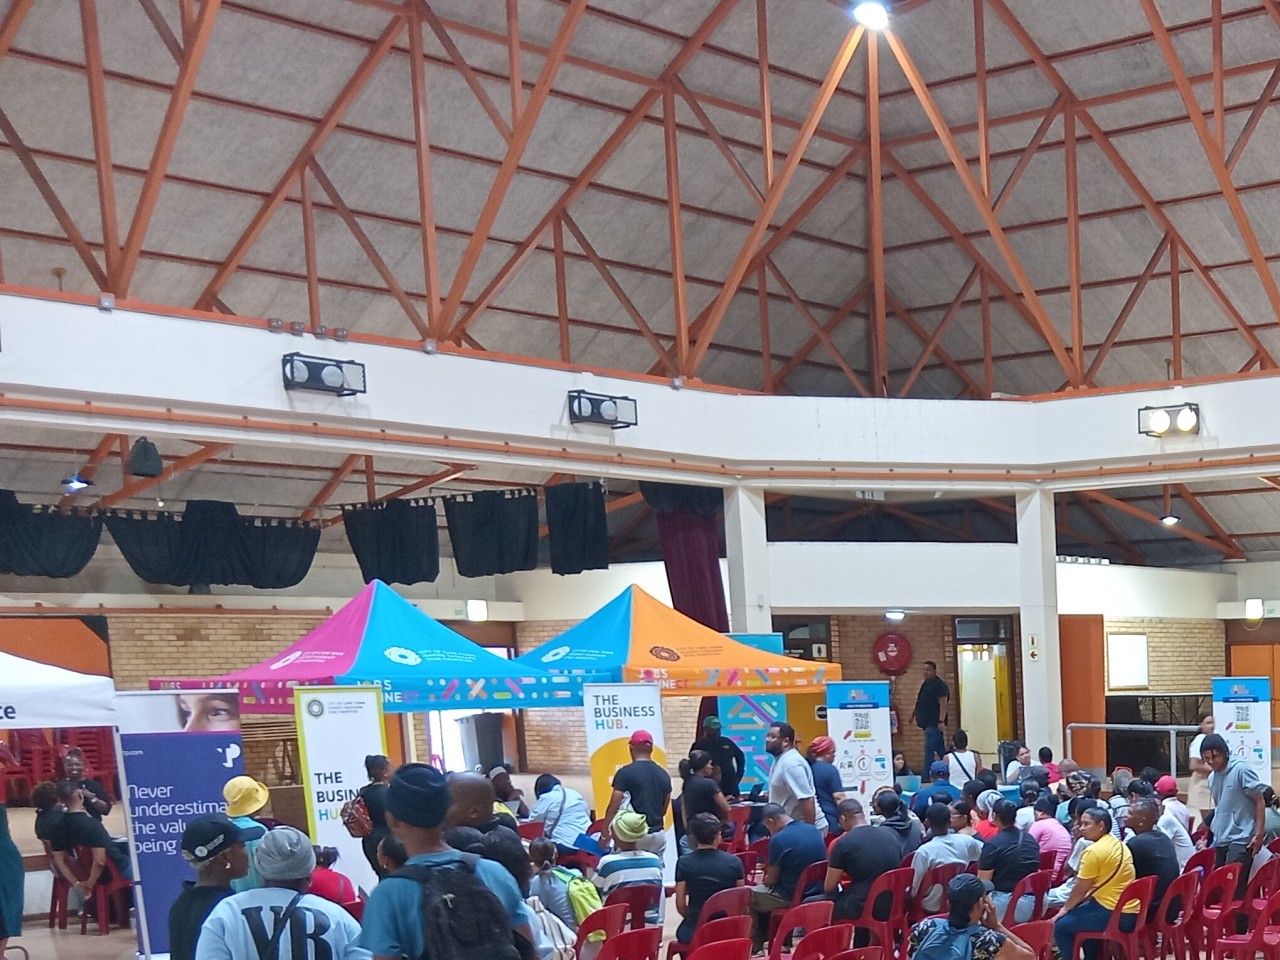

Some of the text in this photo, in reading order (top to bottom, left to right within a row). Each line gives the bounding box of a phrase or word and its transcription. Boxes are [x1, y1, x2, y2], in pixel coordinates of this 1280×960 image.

[593, 694, 619, 706] THE
[594, 706, 655, 718] BUSINESS
[595, 719, 629, 730] HUB.
[314, 771, 343, 785] THE
[316, 788, 360, 803] BUSIN
[130, 801, 228, 817] underestima
[318, 808, 341, 821] HU
